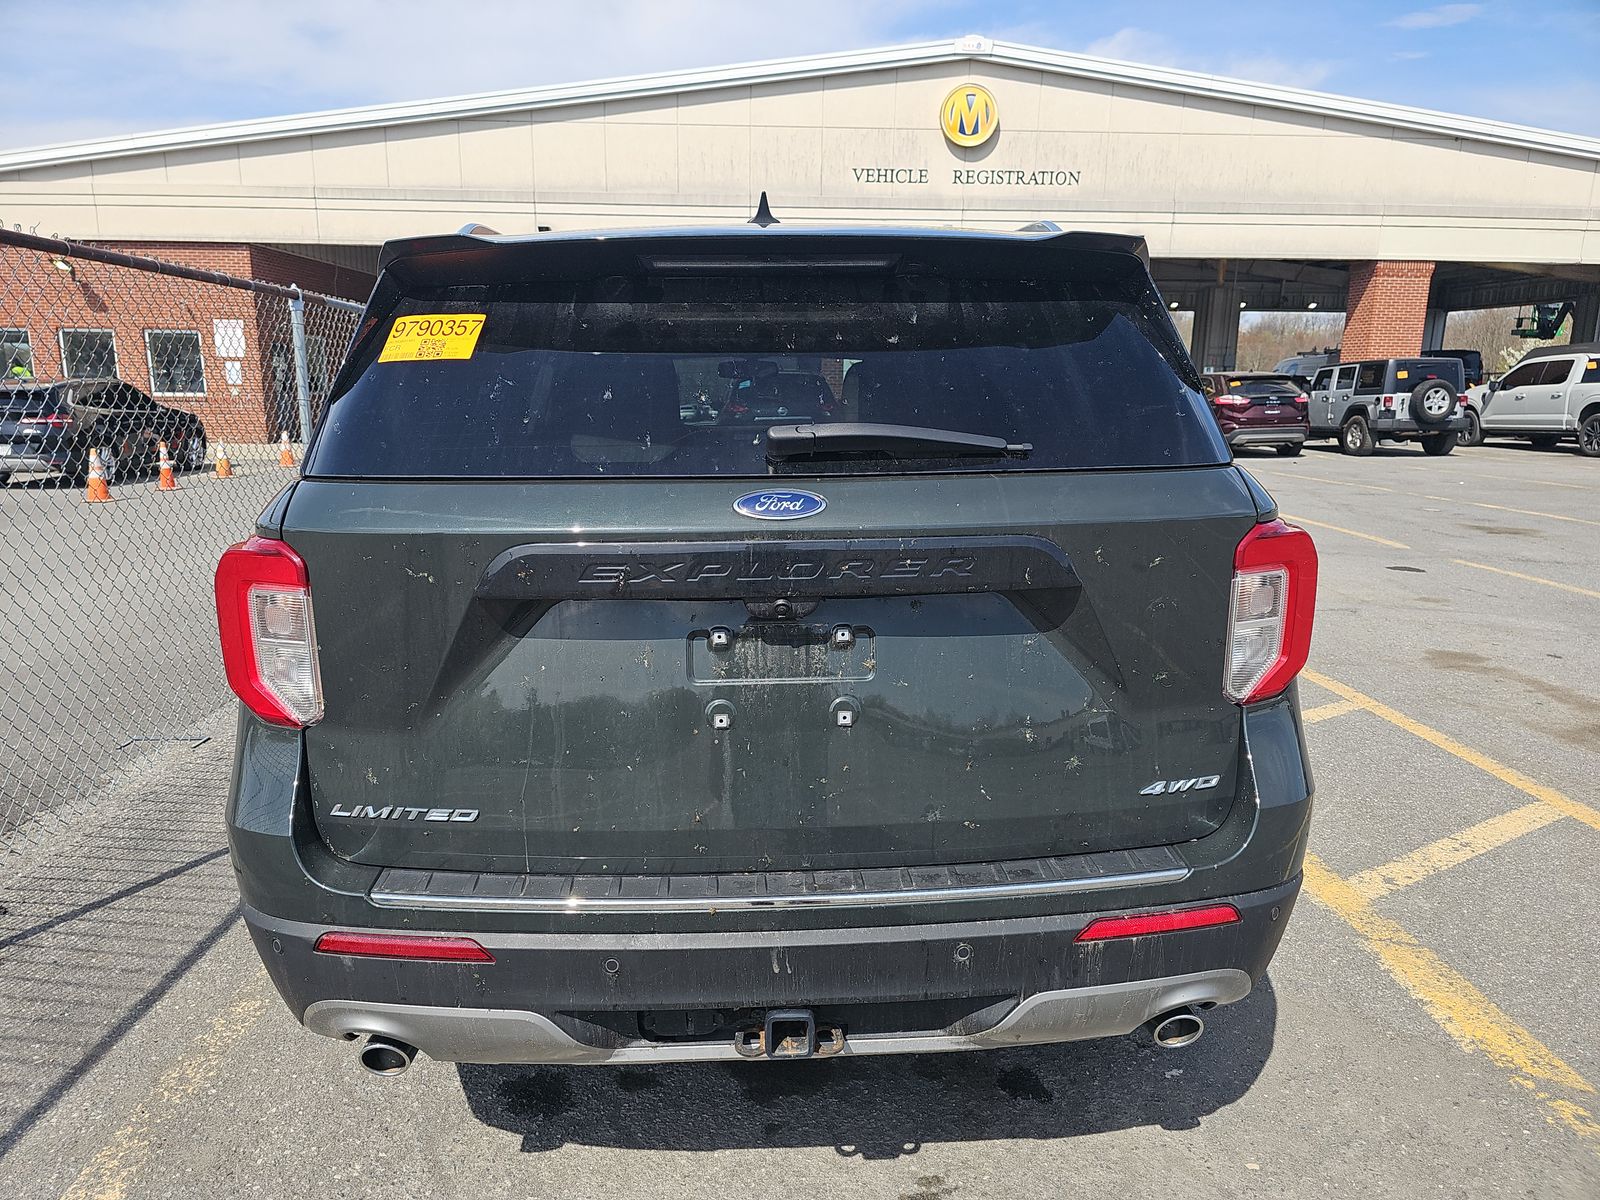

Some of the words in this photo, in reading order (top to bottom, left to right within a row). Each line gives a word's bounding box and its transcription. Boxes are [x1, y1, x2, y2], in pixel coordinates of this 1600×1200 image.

[852, 168, 929, 185] VEHICLE
[952, 169, 1082, 186] REGISTRATION
[392, 319, 484, 339] 9790357
[755, 494, 805, 511] Ford
[578, 558, 977, 583] EXPLORER
[1139, 774, 1221, 796] 4WD
[329, 803, 480, 823] LIMITED
